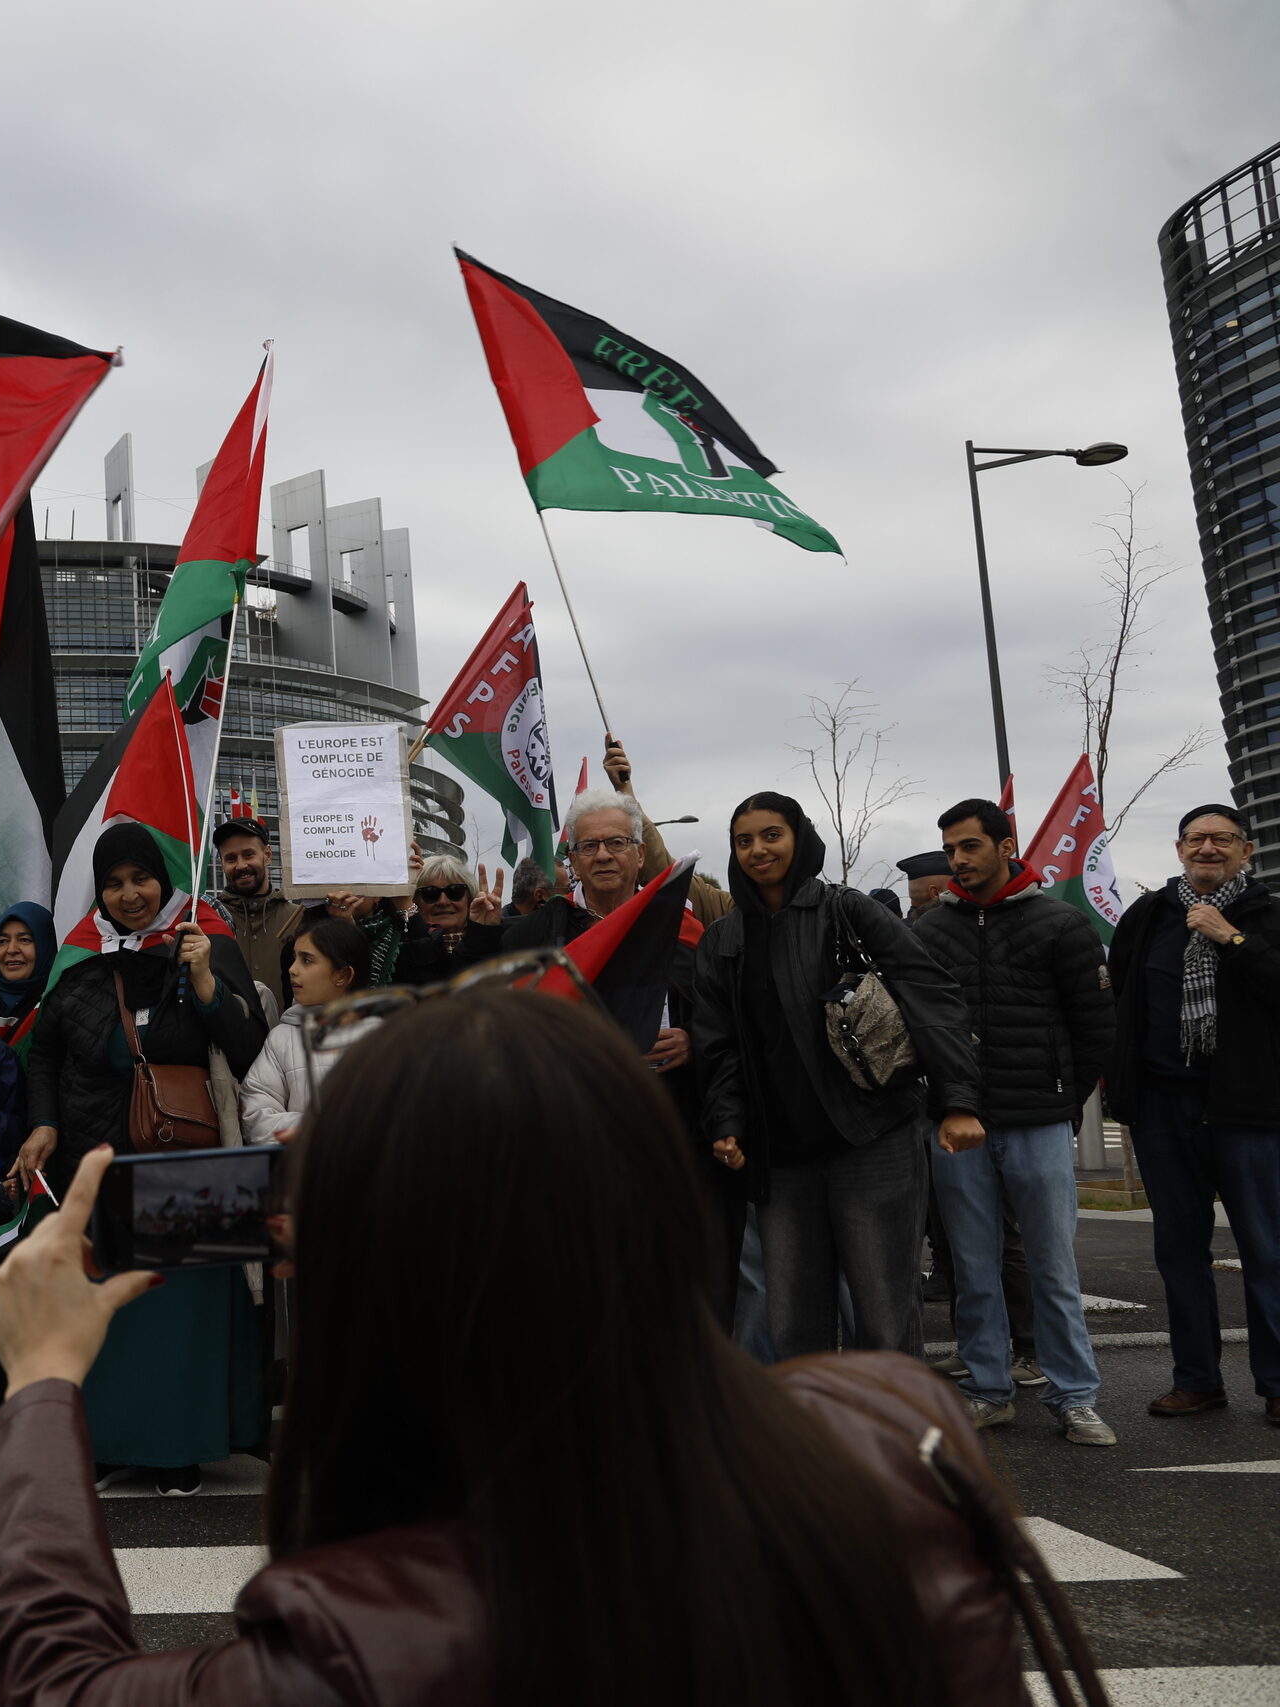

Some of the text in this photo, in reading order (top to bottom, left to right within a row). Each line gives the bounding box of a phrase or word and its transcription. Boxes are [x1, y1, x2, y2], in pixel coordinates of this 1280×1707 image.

[298, 736, 384, 750] L'EUROPE EST
[301, 752, 383, 764] COMPLICE DE
[312, 767, 375, 779] GÉNOCIDE
[303, 814, 354, 823] EUROPE IS
[303, 826, 355, 835] COMPLICIT
[306, 850, 356, 859] GENOCIDE
